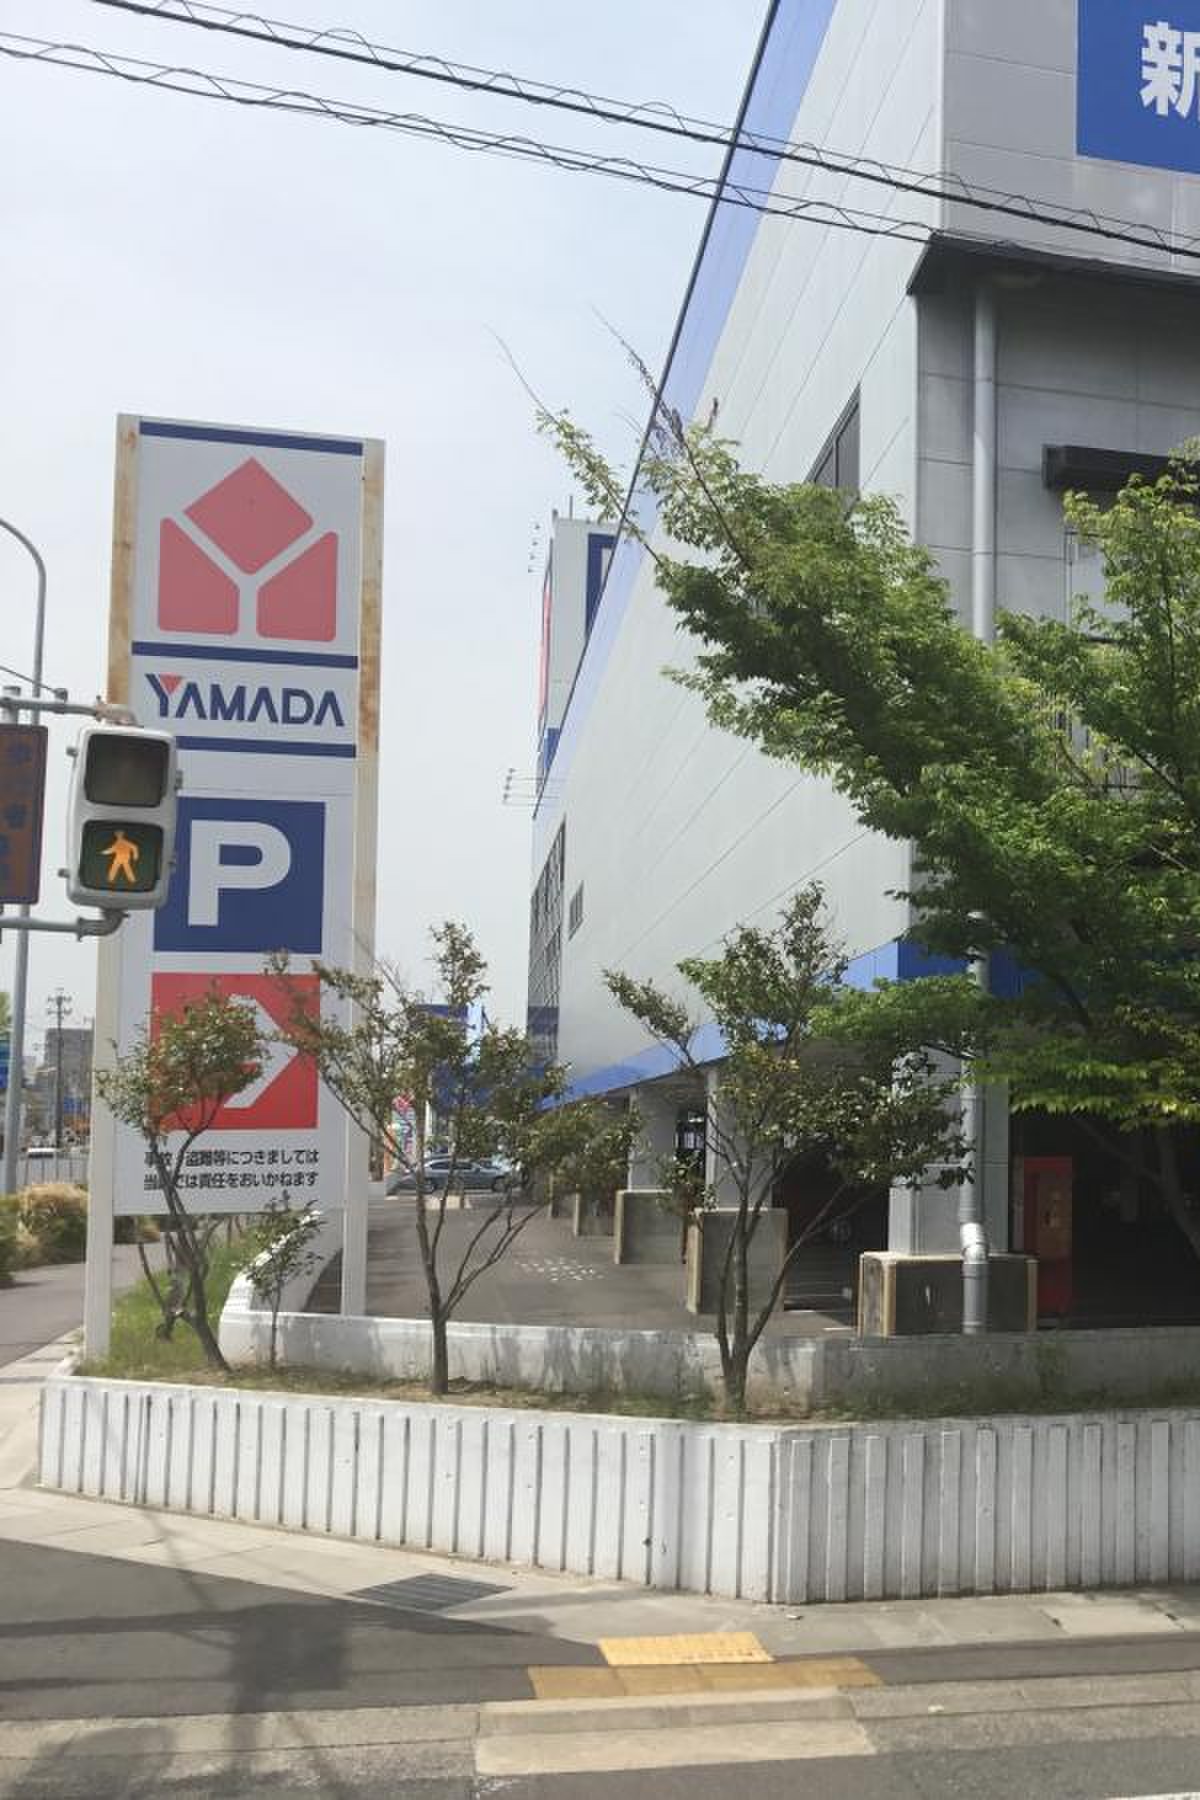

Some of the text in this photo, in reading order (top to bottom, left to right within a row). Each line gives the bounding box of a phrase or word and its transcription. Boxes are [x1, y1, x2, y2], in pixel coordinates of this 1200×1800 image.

[145, 672, 346, 728] YAMADA
[187, 819, 292, 927] P
[144, 1170, 319, 1190] 当では責任をおいかねます
